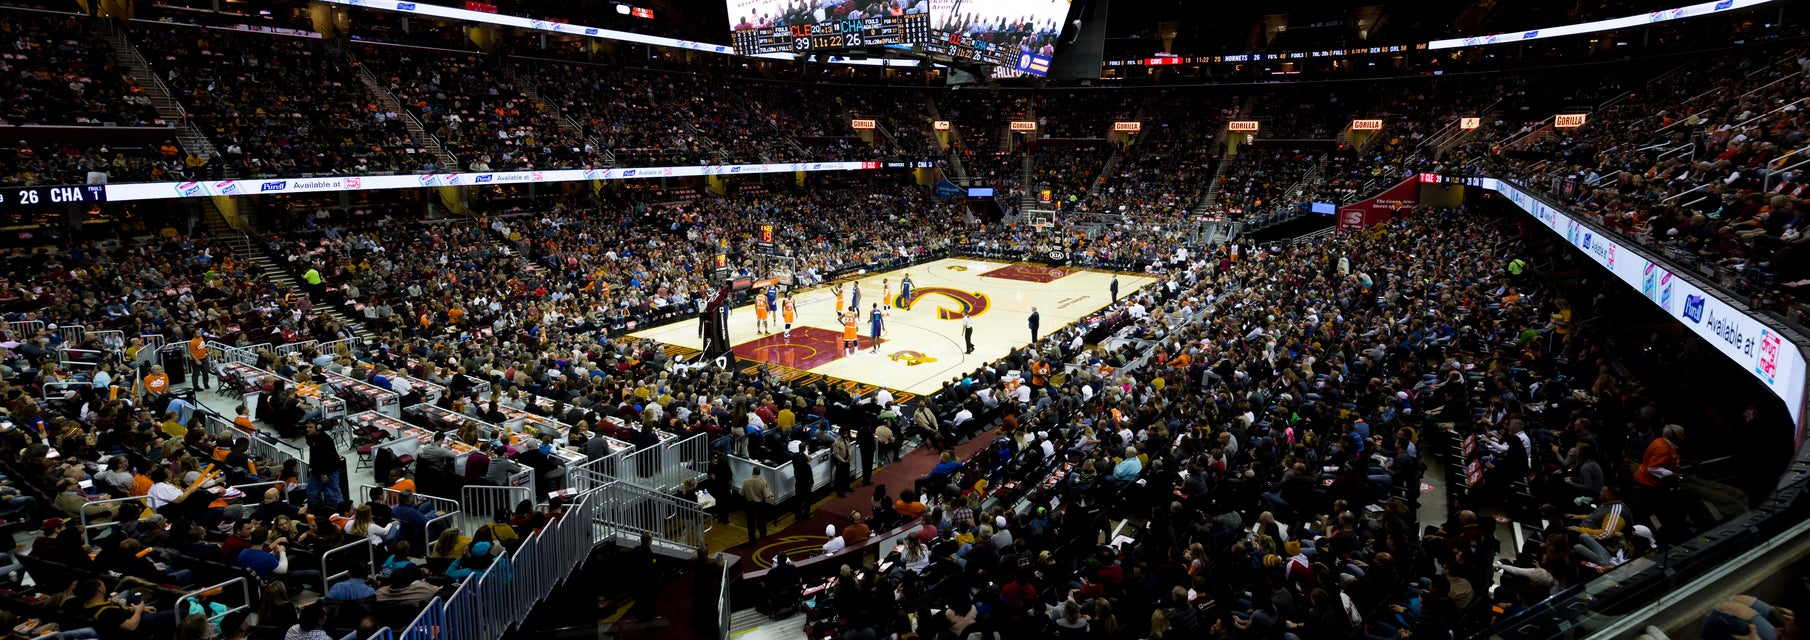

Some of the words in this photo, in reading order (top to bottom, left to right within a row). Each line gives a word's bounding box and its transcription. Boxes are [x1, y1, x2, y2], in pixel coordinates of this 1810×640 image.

[790, 24, 811, 37] CLE
[841, 20, 863, 32] CHA
[795, 38, 809, 49] 39
[846, 34, 860, 46] 26
[950, 34, 962, 45] CLE
[947, 45, 957, 56] 39
[973, 50, 981, 60] 26
[1557, 116, 1583, 125] GORILLA
[1425, 173, 1434, 182] CLE
[262, 181, 285, 190] Purell
[293, 181, 330, 189] Available
[19, 190, 39, 204] 26
[50, 187, 83, 202] CHA
[93, 191, 98, 200] 1
[1684, 295, 1703, 322] Purell
[1706, 309, 1743, 350] Available
[1744, 336, 1755, 358] at
[1761, 339, 1776, 363] drug
[1760, 357, 1775, 378] mart
